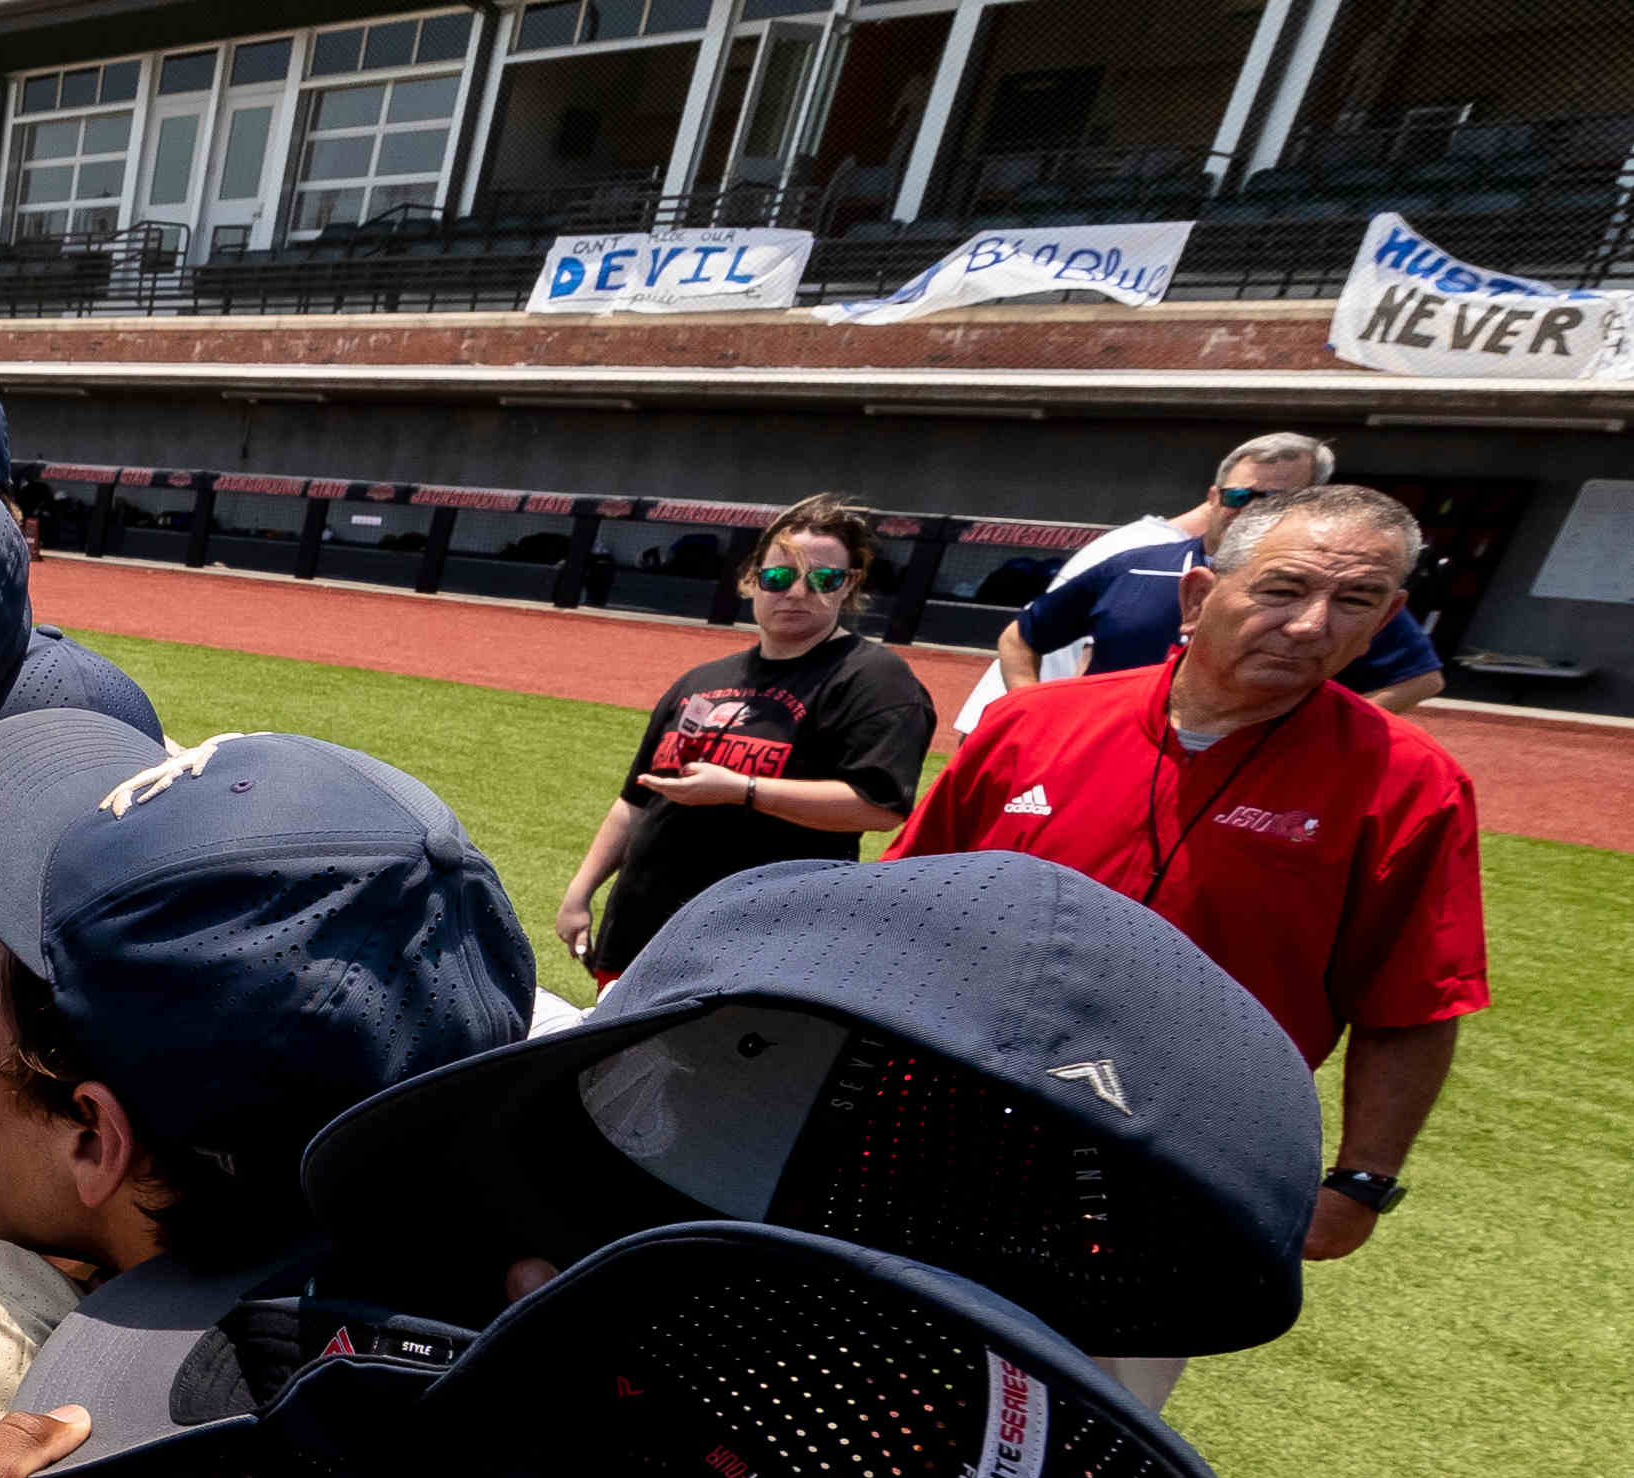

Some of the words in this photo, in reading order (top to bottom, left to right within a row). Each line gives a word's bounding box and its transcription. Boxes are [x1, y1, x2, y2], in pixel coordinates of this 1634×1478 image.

[548, 245, 755, 300] DEVIL
[1358, 283, 1585, 357] NEVER
[1003, 802, 1053, 817] adidas
[1213, 805, 1278, 833] JSU
[401, 1340, 433, 1357] STYLE
